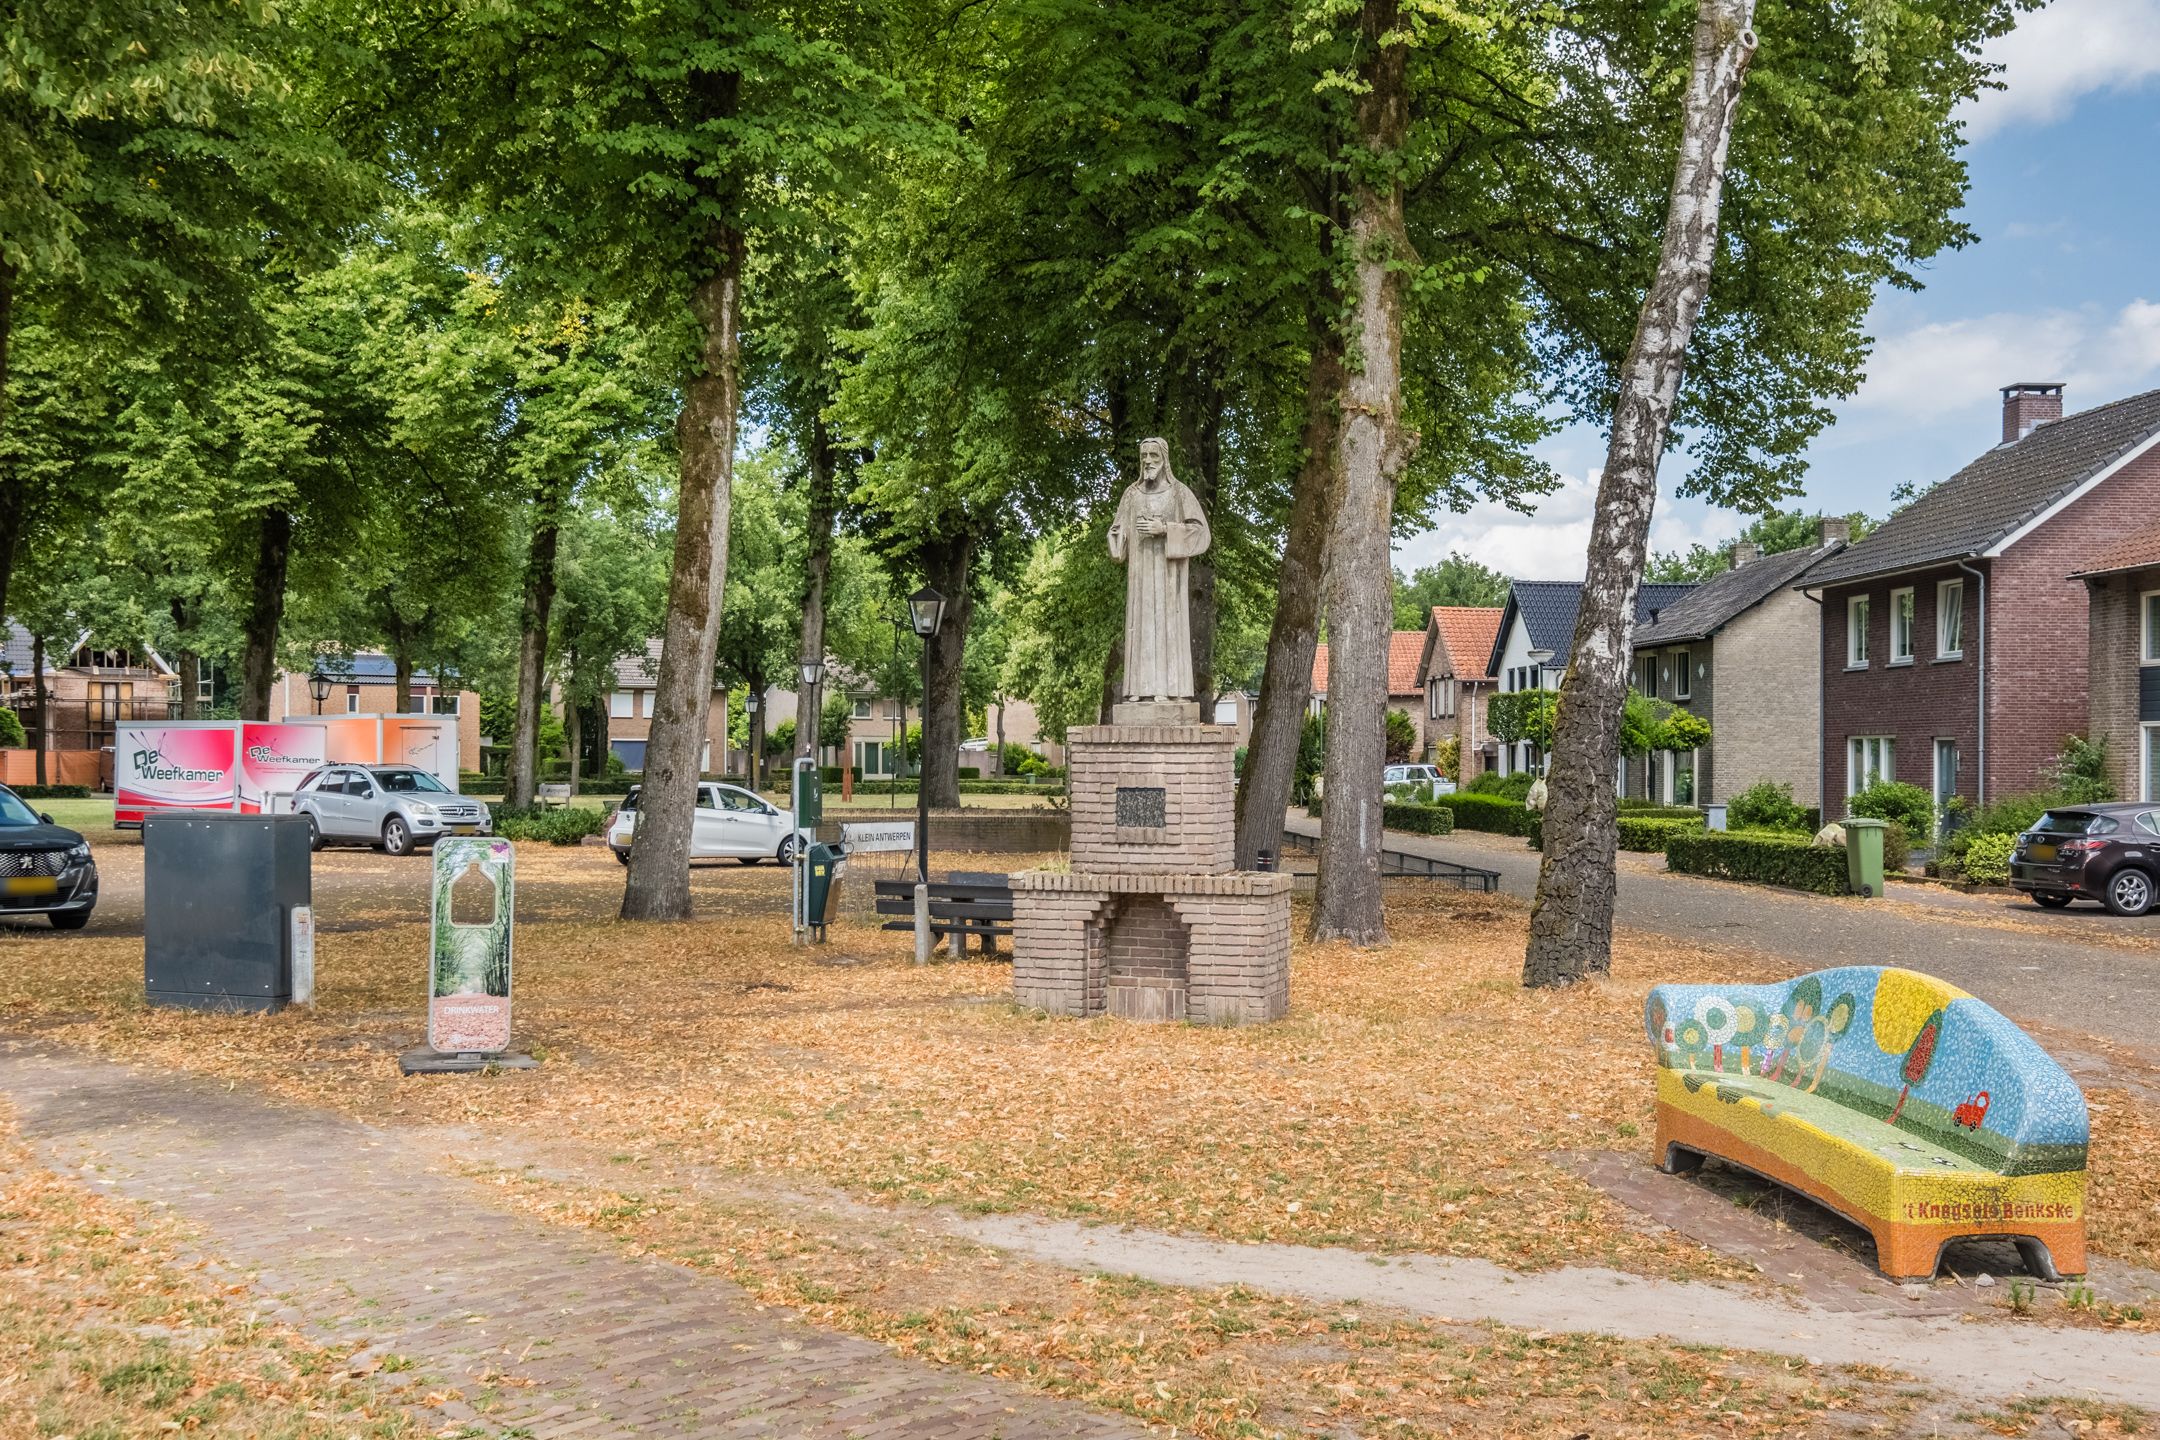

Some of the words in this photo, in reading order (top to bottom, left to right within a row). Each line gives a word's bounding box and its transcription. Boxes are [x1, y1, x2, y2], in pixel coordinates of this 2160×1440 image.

[250, 746, 270, 757] De
[133, 750, 158, 770] De
[257, 754, 320, 764] Weefkamer
[142, 765, 223, 782] Weefkamer
[858, 833, 875, 842] KLEIN
[876, 832, 911, 841] ANTWERPEN
[444, 1006, 499, 1014] DRINKWATER
